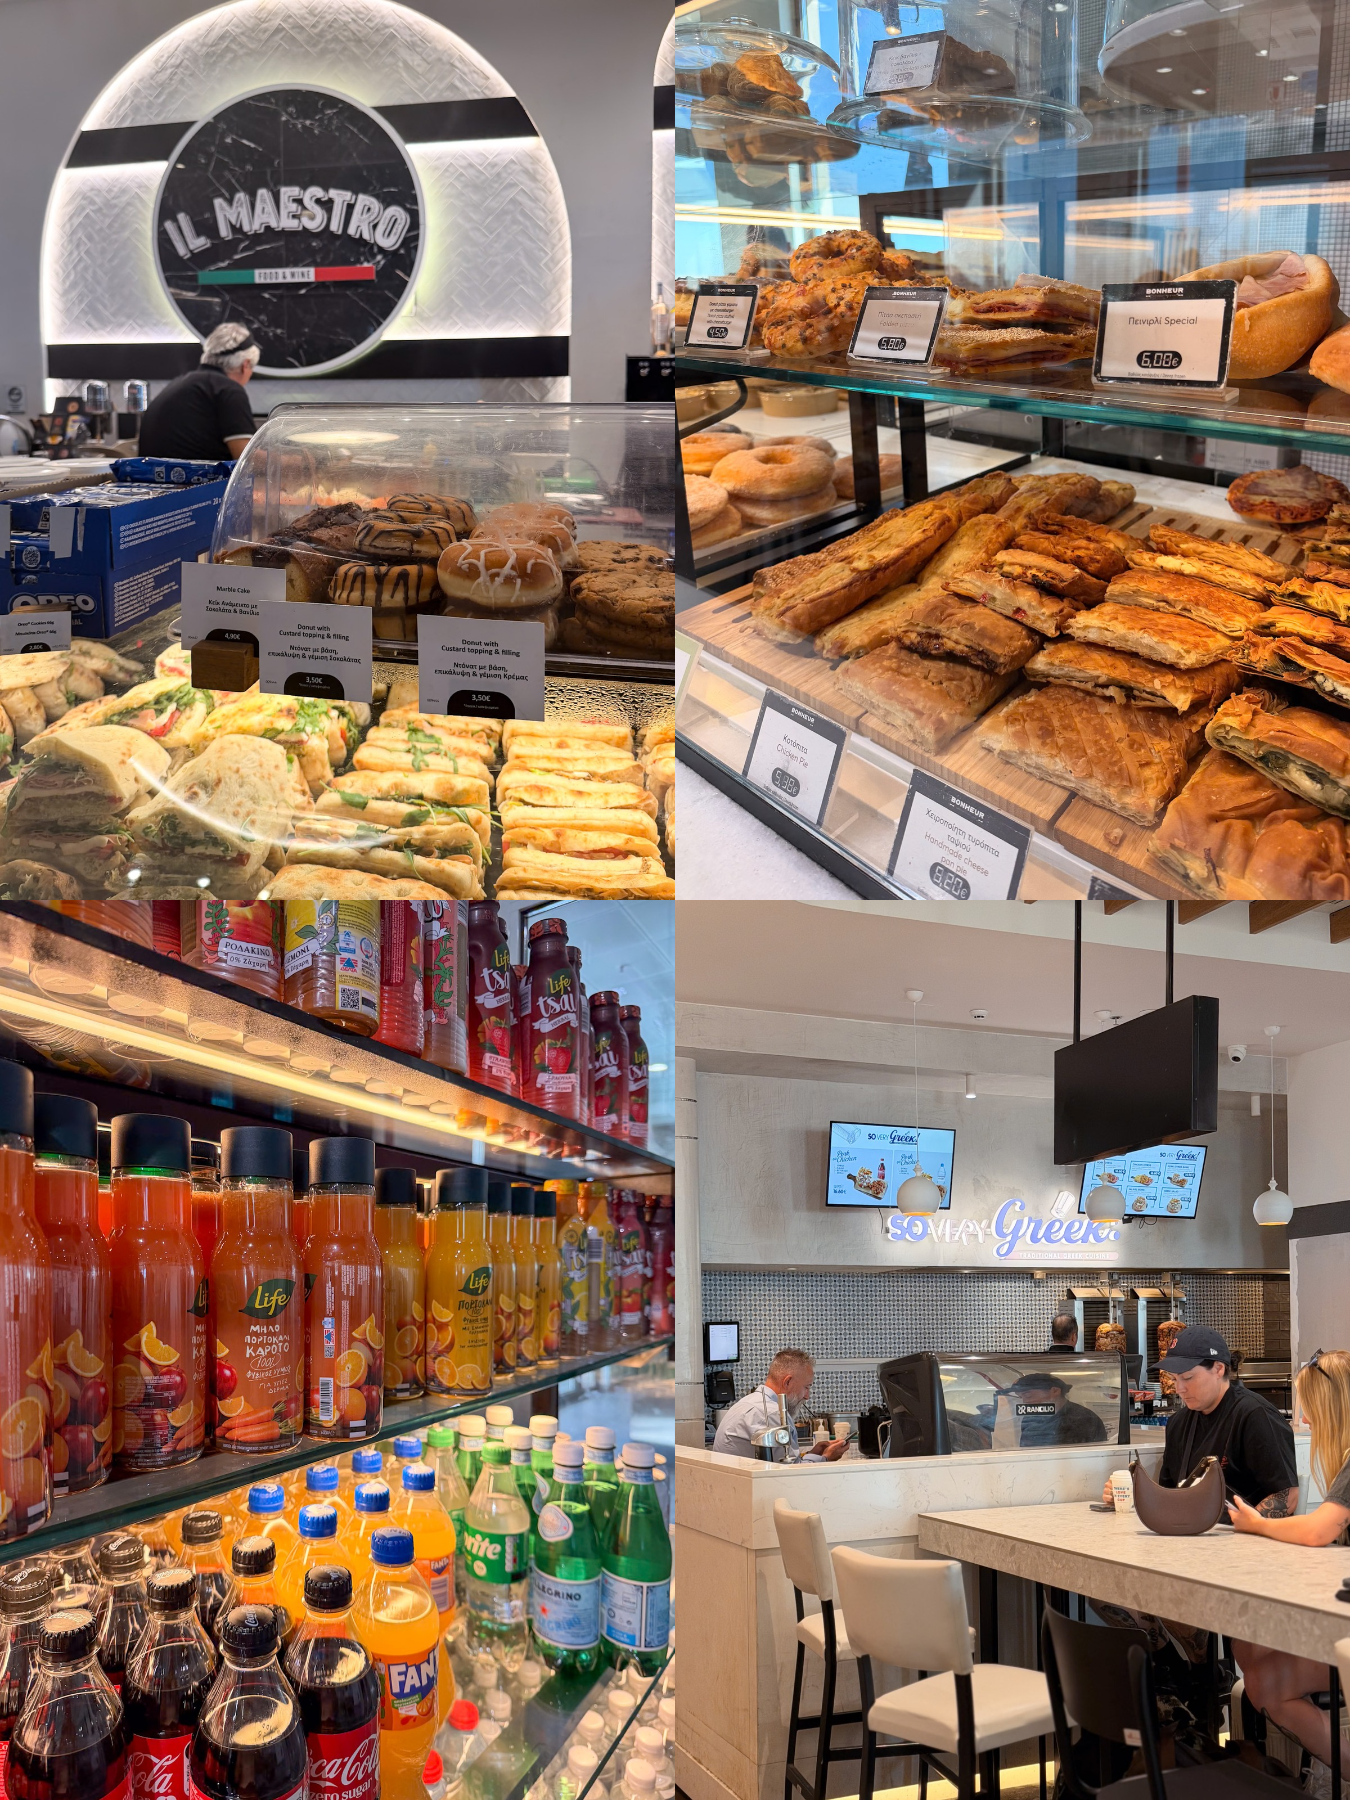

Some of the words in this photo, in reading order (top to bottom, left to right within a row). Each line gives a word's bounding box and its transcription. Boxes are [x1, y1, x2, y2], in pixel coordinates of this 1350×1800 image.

[164, 212, 212, 259] IL
[213, 186, 410, 251] MAESTRO
[257, 270, 280, 281] FOOD
[282, 270, 288, 280] &
[289, 269, 312, 280] WINE
[1145, 287, 1184, 295] BONHEUR
[1128, 316, 1162, 327] Πεινιρλί
[1164, 316, 1198, 325] Special
[1141, 352, 1179, 369] 6,00€
[216, 585, 231, 594] Marble
[232, 586, 251, 595] Cake
[205, 606, 232, 615] Σοκολάτα
[297, 623, 315, 631] Donut
[224, 633, 241, 641] 4,90€
[279, 629, 302, 637] Custard
[302, 631, 326, 640] topping
[332, 633, 350, 642] filling
[289, 644, 311, 652] Ντόνατ
[312, 646, 320, 654] με
[320, 647, 339, 656] βάση,
[441, 645, 466, 653] Custard
[467, 647, 493, 656] topping
[501, 648, 521, 657] filling
[461, 639, 482, 647] Donut
[483, 640, 499, 648] with
[268, 650, 301, 660] επικάλυψη
[307, 652, 328, 662] γέμιση
[329, 654, 362, 665] Σοκολάτας
[453, 662, 477, 670] Ντόνατ
[488, 664, 508, 673] βάση,
[305, 676, 323, 684] 3,50€
[434, 669, 471, 678] επικάλυψη
[479, 671, 502, 680] γέμιση
[503, 673, 529, 682] Κρέμας
[471, 694, 491, 702] 3,50€
[791, 707, 815, 724] BONHEUR
[783, 733, 809, 755] Κοτόπιτα
[776, 743, 799, 763] Chicken
[798, 757, 809, 769] Pie
[951, 795, 985, 820] BONHEUR
[925, 807, 966, 839] Χειροποίητη
[967, 833, 1000, 858] τυρόπιτα
[946, 833, 971, 853] ταψιού
[924, 831, 963, 861] Handmade
[963, 857, 990, 877] cheese
[940, 855, 955, 870] pan
[956, 863, 968, 877] pie
[225, 941, 271, 957] ΡΟΔΑΚΙΝΟ
[229, 955, 241, 963] 0%
[243, 956, 267, 970] Ζάχαρη
[480, 967, 510, 992] tsa
[549, 975, 571, 995] Life
[536, 987, 577, 1018] tsai
[551, 1015, 570, 1028] HERBAL
[595, 1038, 611, 1055] ife
[867, 1132, 877, 1140] SO
[877, 1133, 889, 1141] VERY
[888, 1214, 928, 1242] SO
[469, 1273, 489, 1294] Life
[254, 1285, 290, 1315] Life
[458, 1298, 493, 1311] ΠΟΡΤΟΚΑΛ
[249, 1324, 280, 1334] ΜΗΛΟ
[244, 1334, 290, 1344] ΠΟΡΤΟΚΑΛΙ
[245, 1342, 290, 1358] ΚΑΡΟΤΟ
[1026, 1405, 1055, 1413] RANCILIO
[341, 1777, 373, 1800] sugar
